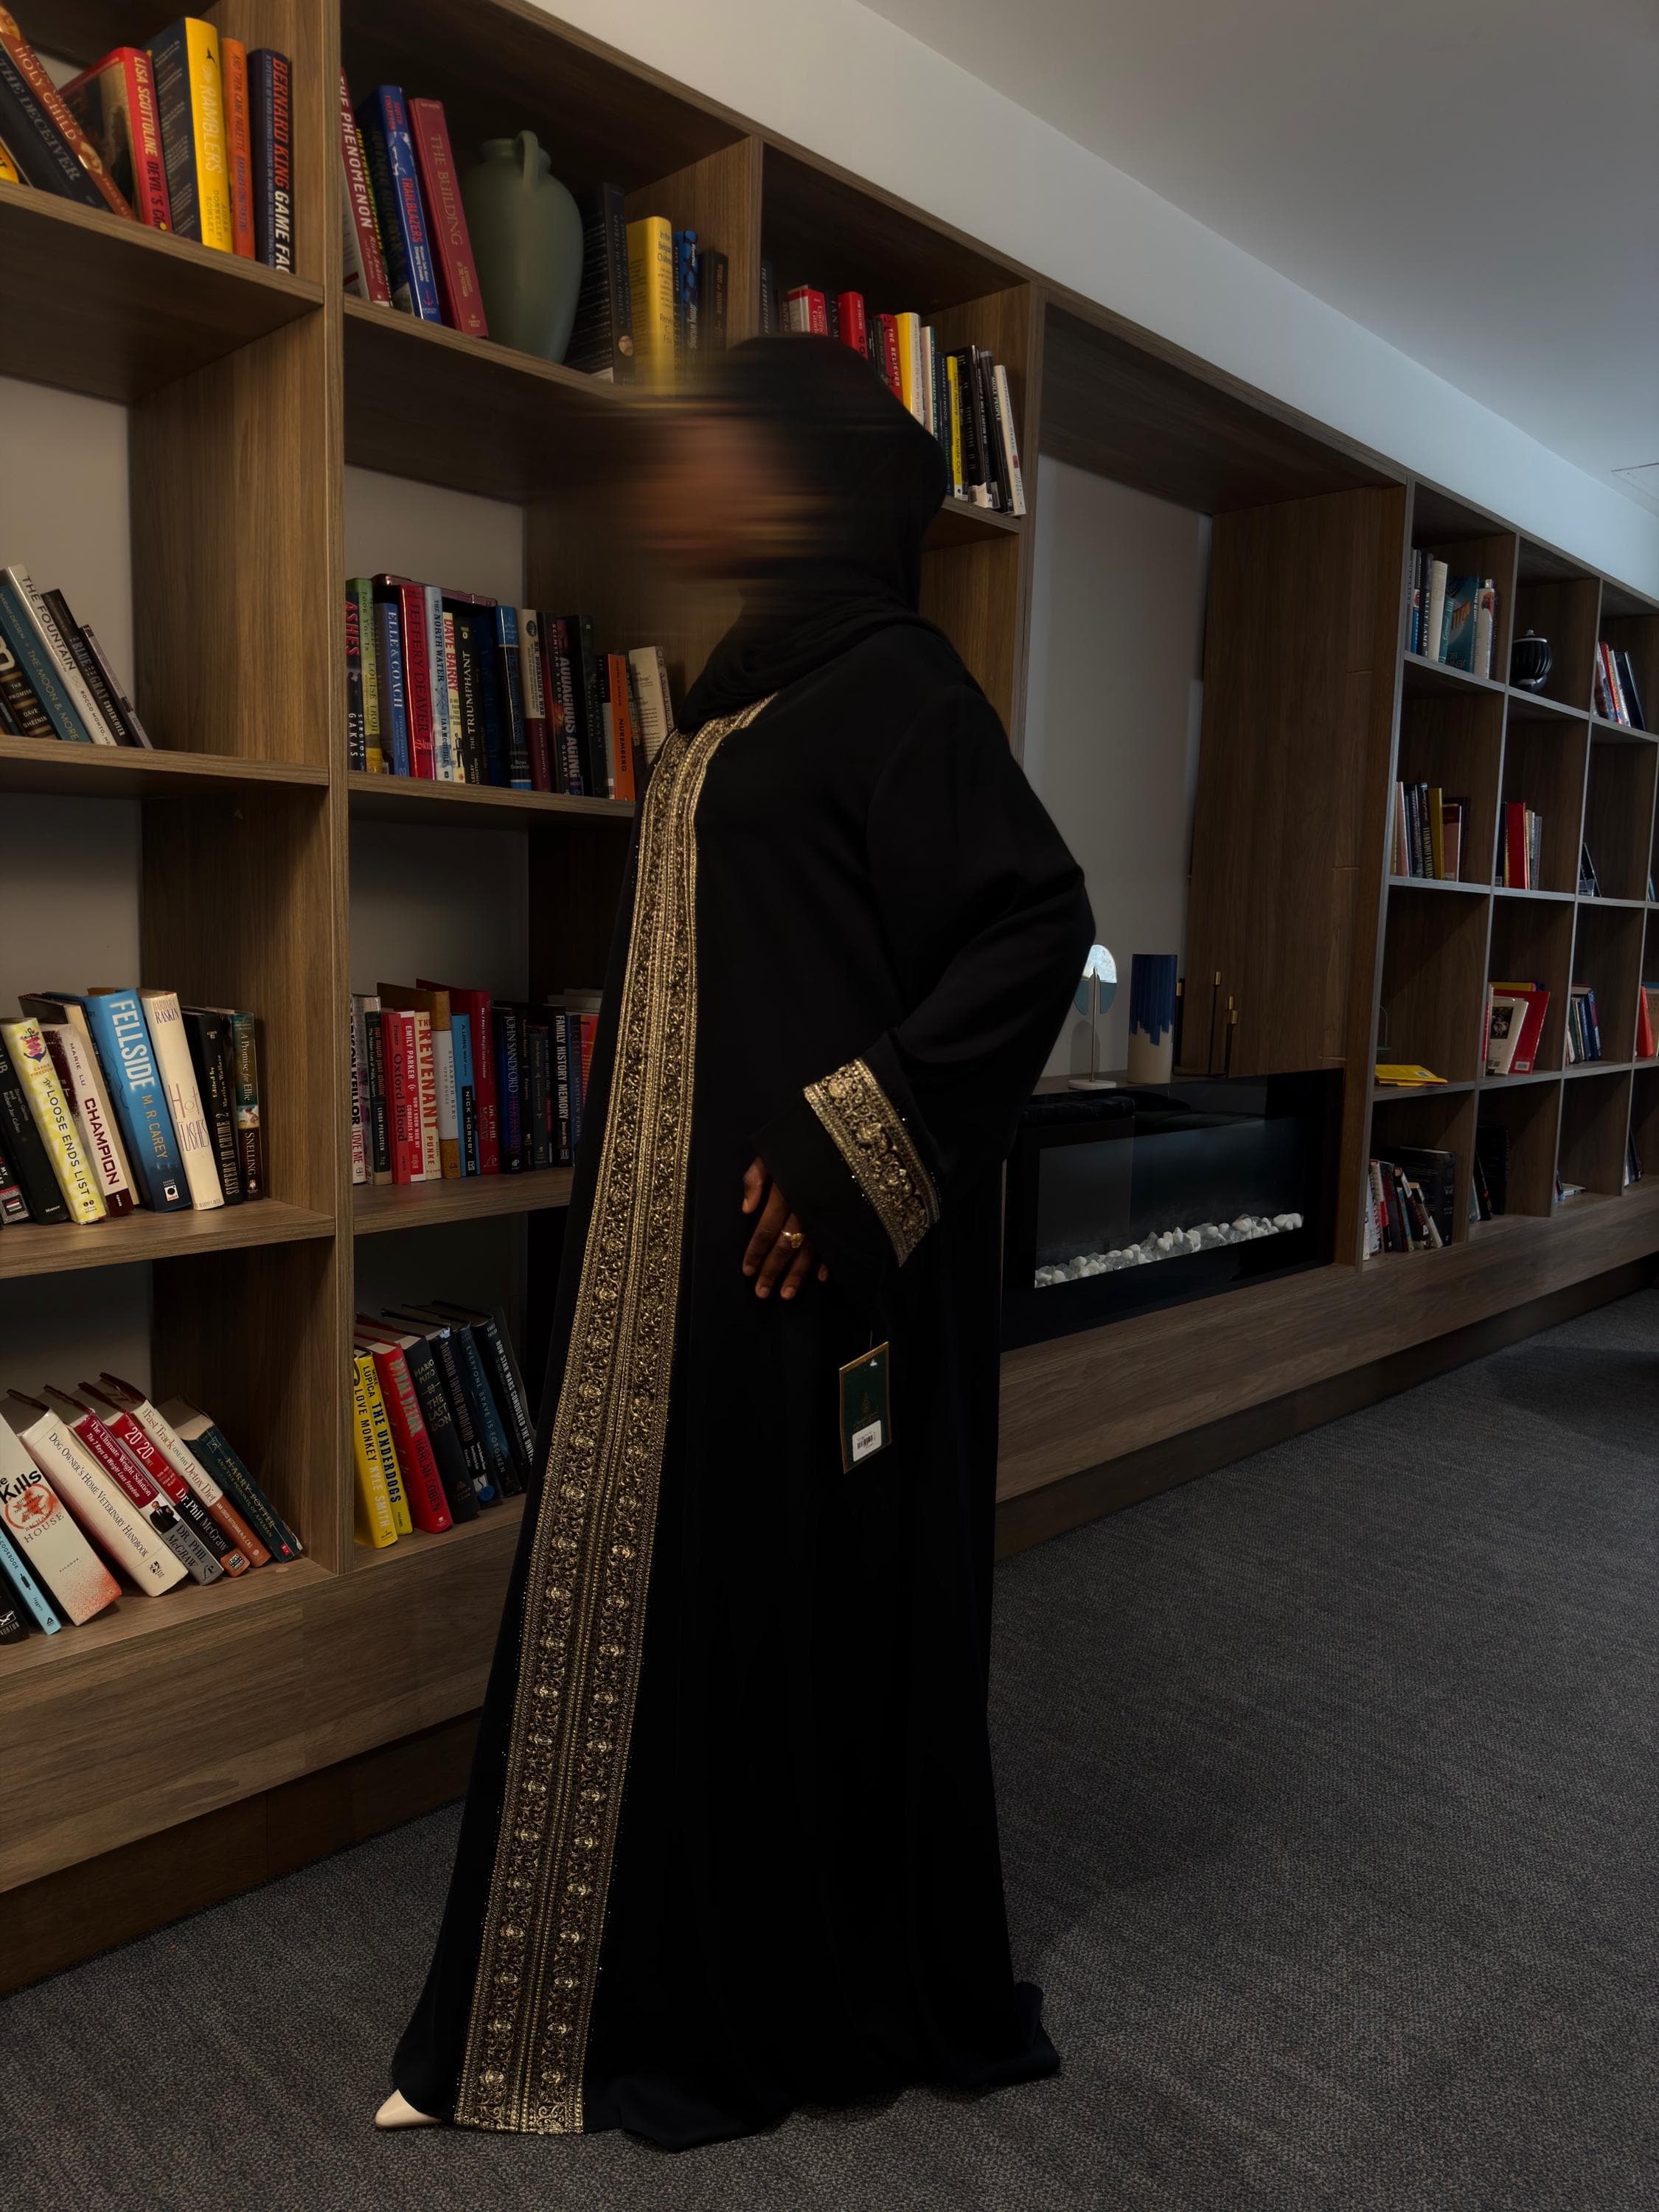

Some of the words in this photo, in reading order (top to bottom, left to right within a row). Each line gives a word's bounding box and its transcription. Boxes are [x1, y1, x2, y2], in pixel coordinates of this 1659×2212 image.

[133, 55, 147, 85] LISA
[13, 45, 44, 88] HOLY
[41, 90, 77, 142] CHILD
[272, 58, 288, 143] BERNARD
[18, 91, 82, 184] DECEIVER
[137, 87, 159, 157] SCOTTOLINE
[201, 85, 222, 174] RAMBLERS
[273, 142, 289, 189] KING
[341, 111, 372, 228] PHENOMENON
[428, 133, 446, 167] THE
[437, 170, 462, 246] BUILDING
[274, 189, 289, 241] GAME
[400, 175, 423, 243] TRAILBLAZERS
[886, 327, 895, 343] THE
[888, 346, 902, 387] BELIEVER
[20, 574, 41, 602] THE
[38, 605, 77, 671] FOUNTAIN
[345, 600, 361, 656] ASHES
[385, 611, 400, 647] ELLE
[407, 602, 425, 668] JEFFERY
[432, 614, 442, 649] NORTH
[442, 618, 456, 648] DAVE
[1421, 624, 1430, 647] LAMB
[25, 648, 41, 667] THE
[71, 639, 93, 667] BLUE
[389, 648, 399, 657] &
[434, 650, 444, 681] WATER
[34, 666, 58, 698] MOON
[88, 673, 110, 701] GRAY
[388, 660, 403, 708] COACH
[445, 652, 459, 692] BARRY
[8, 689, 32, 700] PROMISE
[54, 701, 63, 710] &
[413, 671, 430, 733] DEAVER
[462, 650, 476, 734] TRIUMPHANT
[558, 656, 577, 734] AUDACIOUS
[23, 708, 38, 717] DAVE
[57, 710, 80, 742] MORE
[347, 712, 359, 757] GAKAS
[357, 713, 366, 757] SERGIOS
[616, 718, 628, 772] NUREMBERG
[560, 743, 568, 779] OLASKY
[564, 734, 581, 778] AGING
[155, 1007, 180, 1024] RASKIN
[503, 1015, 516, 1040] JOHN
[552, 1015, 566, 1044] FAMILY
[108, 999, 156, 1092] FELLSIDE
[375, 1039, 383, 1057] much
[405, 1025, 414, 1047] EMILY
[68, 1042, 82, 1070] MARIE
[77, 1074, 86, 1087] LU
[239, 1040, 251, 1071] Promise
[375, 1059, 384, 1074] just
[406, 1050, 416, 1079] PARKER
[505, 1043, 518, 1092] SANDFORD
[554, 1046, 568, 1081] HISTORY
[241, 1074, 249, 1082] for
[392, 1052, 405, 1099] Oxford
[419, 1030, 439, 1130] REVENANT
[140, 1093, 153, 1105] M.
[242, 1083, 252, 1102] Ellie
[349, 1071, 361, 1125] KEILLOR
[464, 1090, 472, 1112] NICK
[556, 1082, 569, 1119] MEMORY
[144, 1108, 158, 1121] R.
[394, 1102, 408, 1142] Blood
[405, 1104, 413, 1130] COMRADES
[488, 1120, 496, 1142] PHIL
[47, 1090, 68, 1133] LOOSE
[62, 1134, 80, 1167] ENDS
[73, 1169, 91, 1197] LIST
[85, 1098, 119, 1184] CHAMPION
[147, 1122, 170, 1160] CAREY
[177, 1120, 209, 1152] FLASHES
[215, 1120, 233, 1148] CRIME
[352, 1130, 362, 1150] LOVE
[377, 1124, 386, 1151] PERLSTEIN
[424, 1135, 437, 1165] PUNKE
[464, 1116, 474, 1154] HORNBY
[220, 1149, 235, 1160] IN
[243, 1132, 259, 1176] SNELLING
[353, 1151, 363, 1163] ME
[221, 1161, 240, 1194] SISTERS
[437, 1341, 459, 1377] BARBARA
[495, 1338, 506, 1354] HOW
[499, 1354, 510, 1371] STAR
[363, 1366, 376, 1399] LUPICA
[370, 1368, 379, 1386] MIKE
[414, 1359, 435, 1377] MARIO
[419, 1368, 436, 1384] PUZO
[504, 1370, 516, 1391] WARS
[354, 1388, 368, 1416] LOVE
[427, 1393, 444, 1406] THE
[446, 1374, 467, 1405] TAYLOR
[371, 1402, 386, 1426] THE
[428, 1402, 448, 1422] LAST
[431, 1412, 452, 1432] DON
[453, 1403, 477, 1443] BRADFORD
[465, 1344, 483, 1388] EVERYONE
[477, 1391, 491, 1417] BRAVE
[488, 1431, 507, 1473] FORGIVEN
[509, 1391, 526, 1427] CONQUERED
[360, 1419, 378, 1461] MONKEY
[519, 1425, 530, 1439] THE
[88, 1419, 102, 1435] The
[98, 1431, 122, 1458] Ultimate
[115, 1453, 136, 1477] Weight
[131, 1472, 153, 1497] Solution
[104, 1456, 122, 1475] Weight
[142, 1409, 161, 1429] Fast
[153, 1423, 177, 1450] Track
[170, 1446, 189, 1467] ONE-DAY
[182, 1461, 206, 1488] Detox
[199, 1483, 218, 1503] Diet
[377, 1429, 402, 1504] UNDERDOGS
[0, 1470, 42, 1504] Kills
[369, 1464, 383, 1492] KYLE
[413, 1438, 433, 1477] HARLAN
[425, 1478, 442, 1512] COBEN
[47, 1432, 66, 1451] DOG
[59, 1446, 86, 1477] OWNER'S
[80, 1472, 102, 1495] HOME
[94, 1490, 128, 1528] VETERINARY
[121, 1524, 150, 1558] HANDBOOK
[223, 1456, 253, 1494] HARRY
[248, 1493, 276, 1529] POTTER
[24, 1512, 64, 1543] HOUSE
[174, 1486, 193, 1506] Dr.
[184, 1499, 205, 1520] Phil
[198, 1516, 231, 1553] McGraw
[373, 1495, 392, 1528] SMITH
[166, 1533, 200, 1570] McGRAW
[175, 1524, 192, 1543] DR.
[187, 1538, 210, 1563] PHIL
